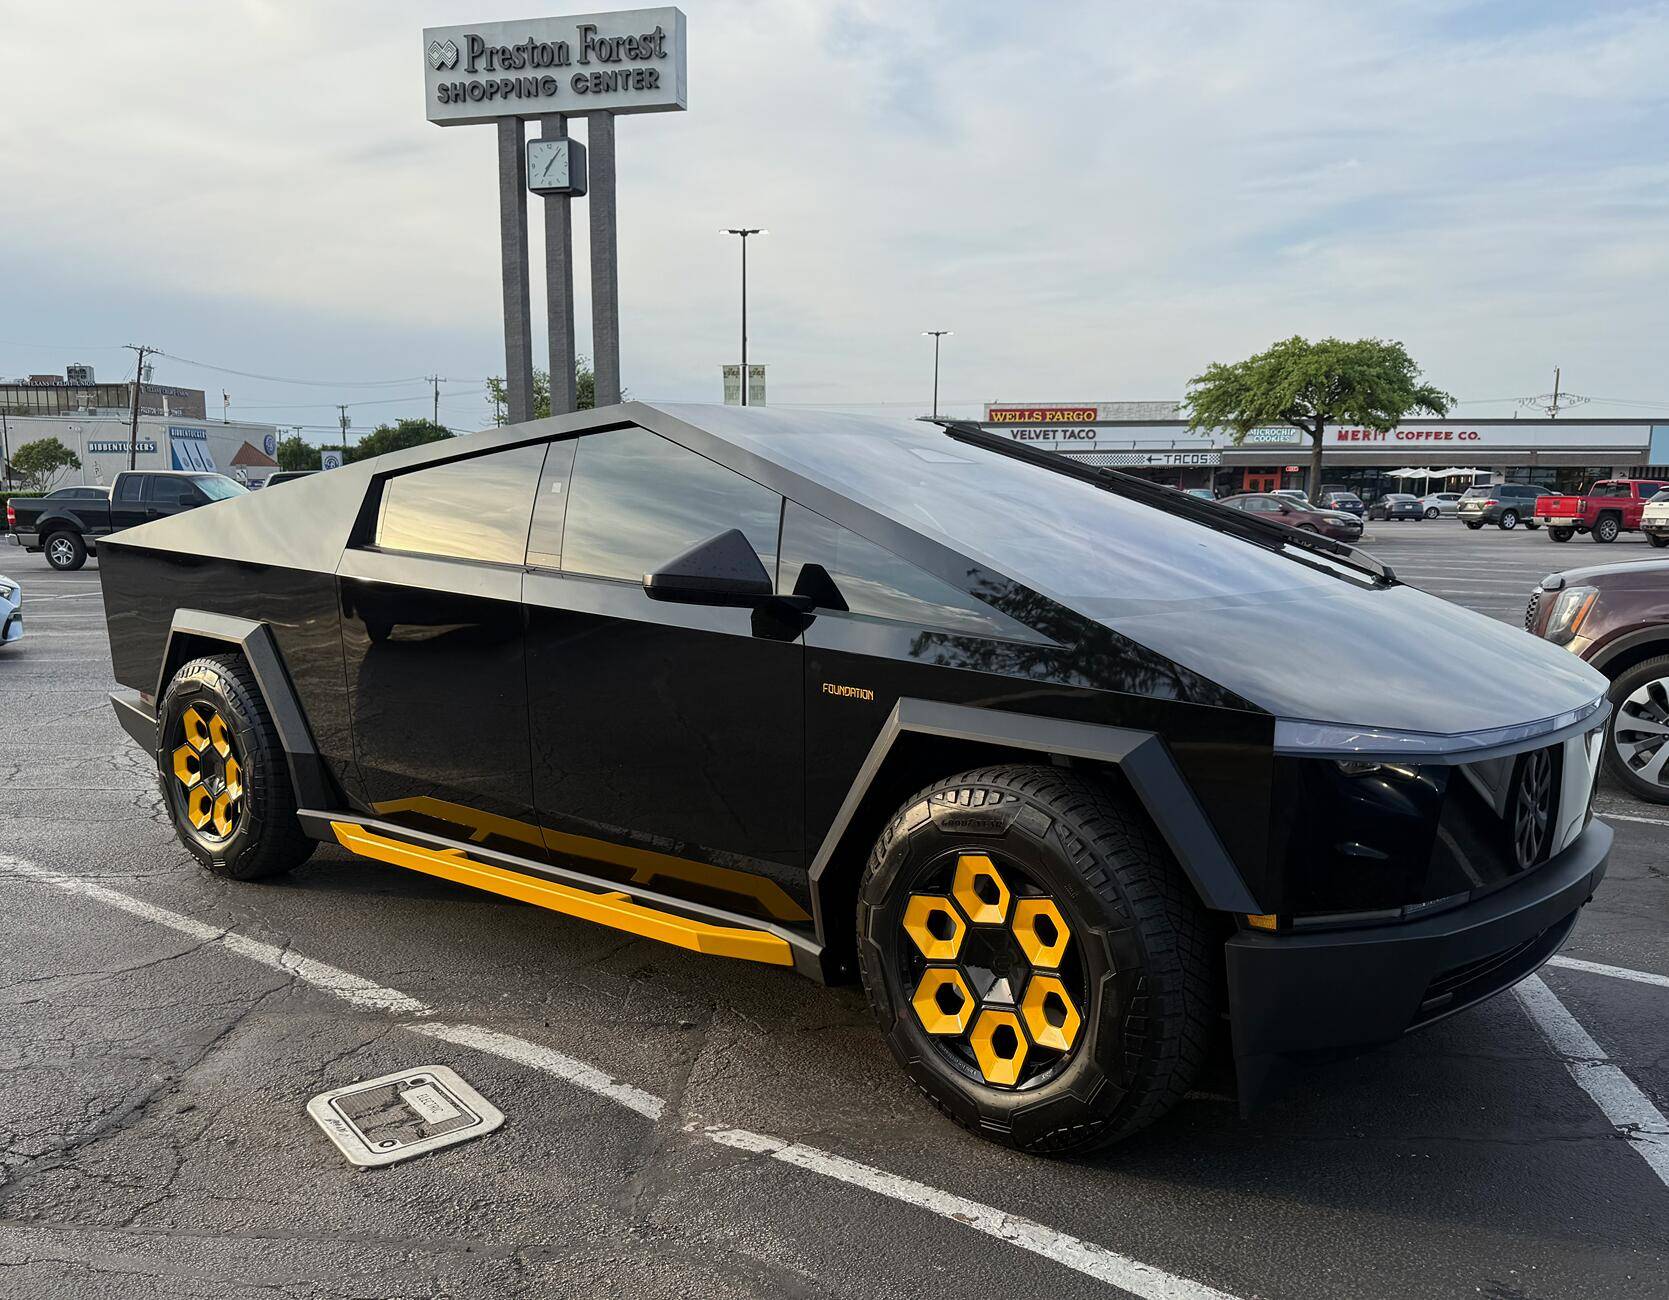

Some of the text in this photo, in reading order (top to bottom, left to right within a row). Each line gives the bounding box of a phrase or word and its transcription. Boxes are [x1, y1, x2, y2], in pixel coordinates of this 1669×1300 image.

[464, 24, 667, 73] Preston Forest
[437, 67, 660, 103] SHOPPING CENTER
[991, 411, 1095, 422] WELLS FARGO
[1011, 429, 1096, 440] VELVET TACO
[1337, 430, 1481, 441] MERIT COFFEE CO.
[1163, 454, 1208, 464] TACOS
[822, 683, 874, 701] FOUNDATION
